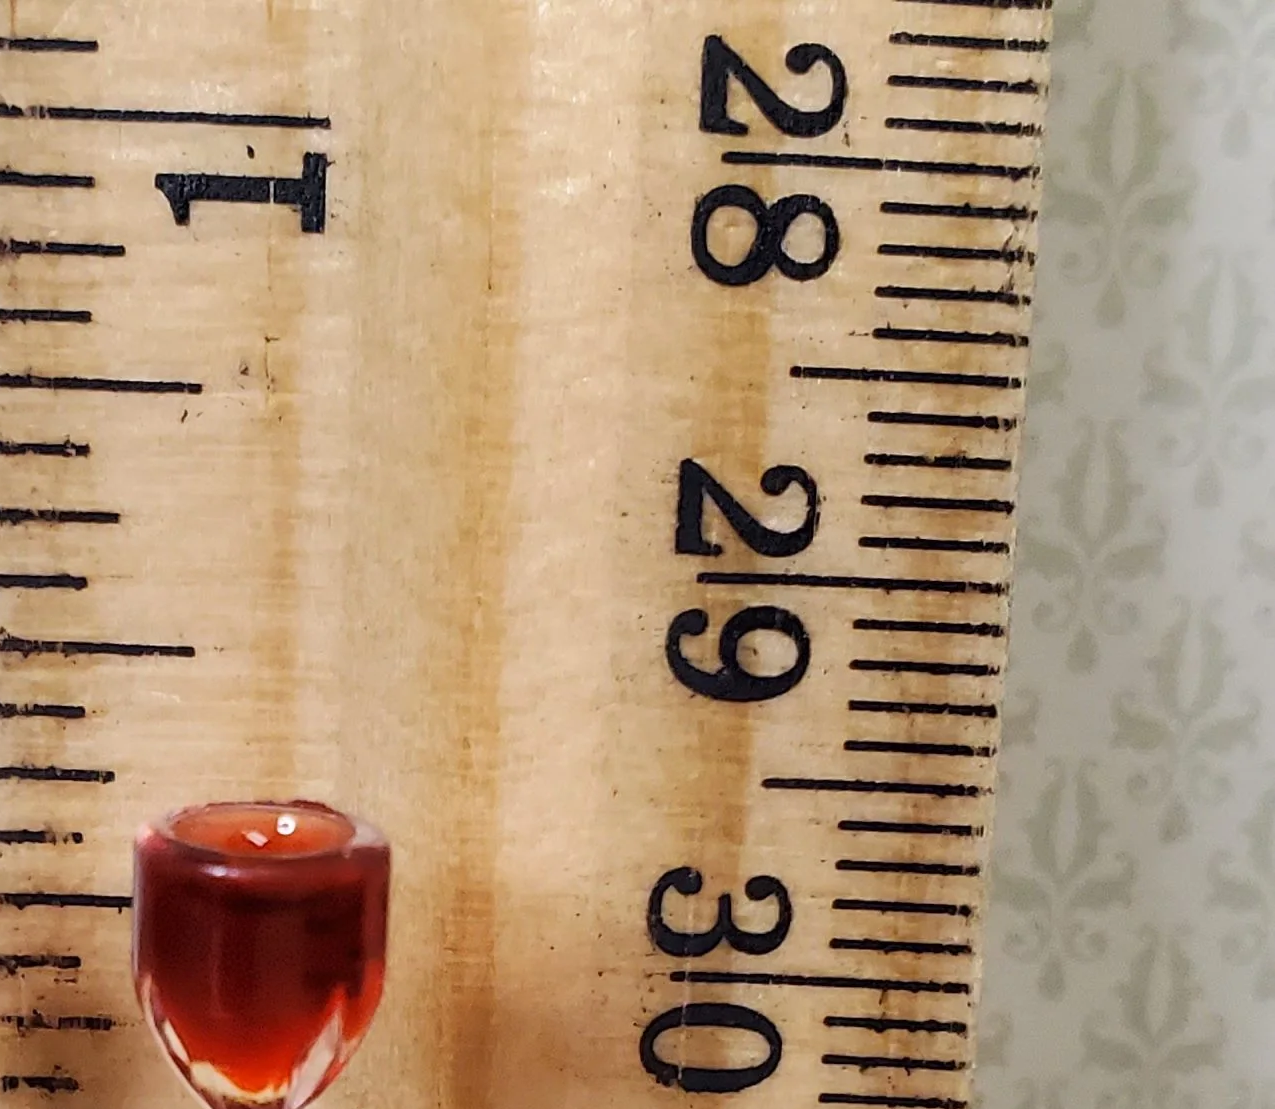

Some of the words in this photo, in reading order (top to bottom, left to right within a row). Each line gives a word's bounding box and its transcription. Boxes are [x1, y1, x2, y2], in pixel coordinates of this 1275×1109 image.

[154, 151, 328, 234] 1
[690, 34, 849, 288] 28
[664, 457, 822, 704] 29
[638, 865, 793, 1096] 30
